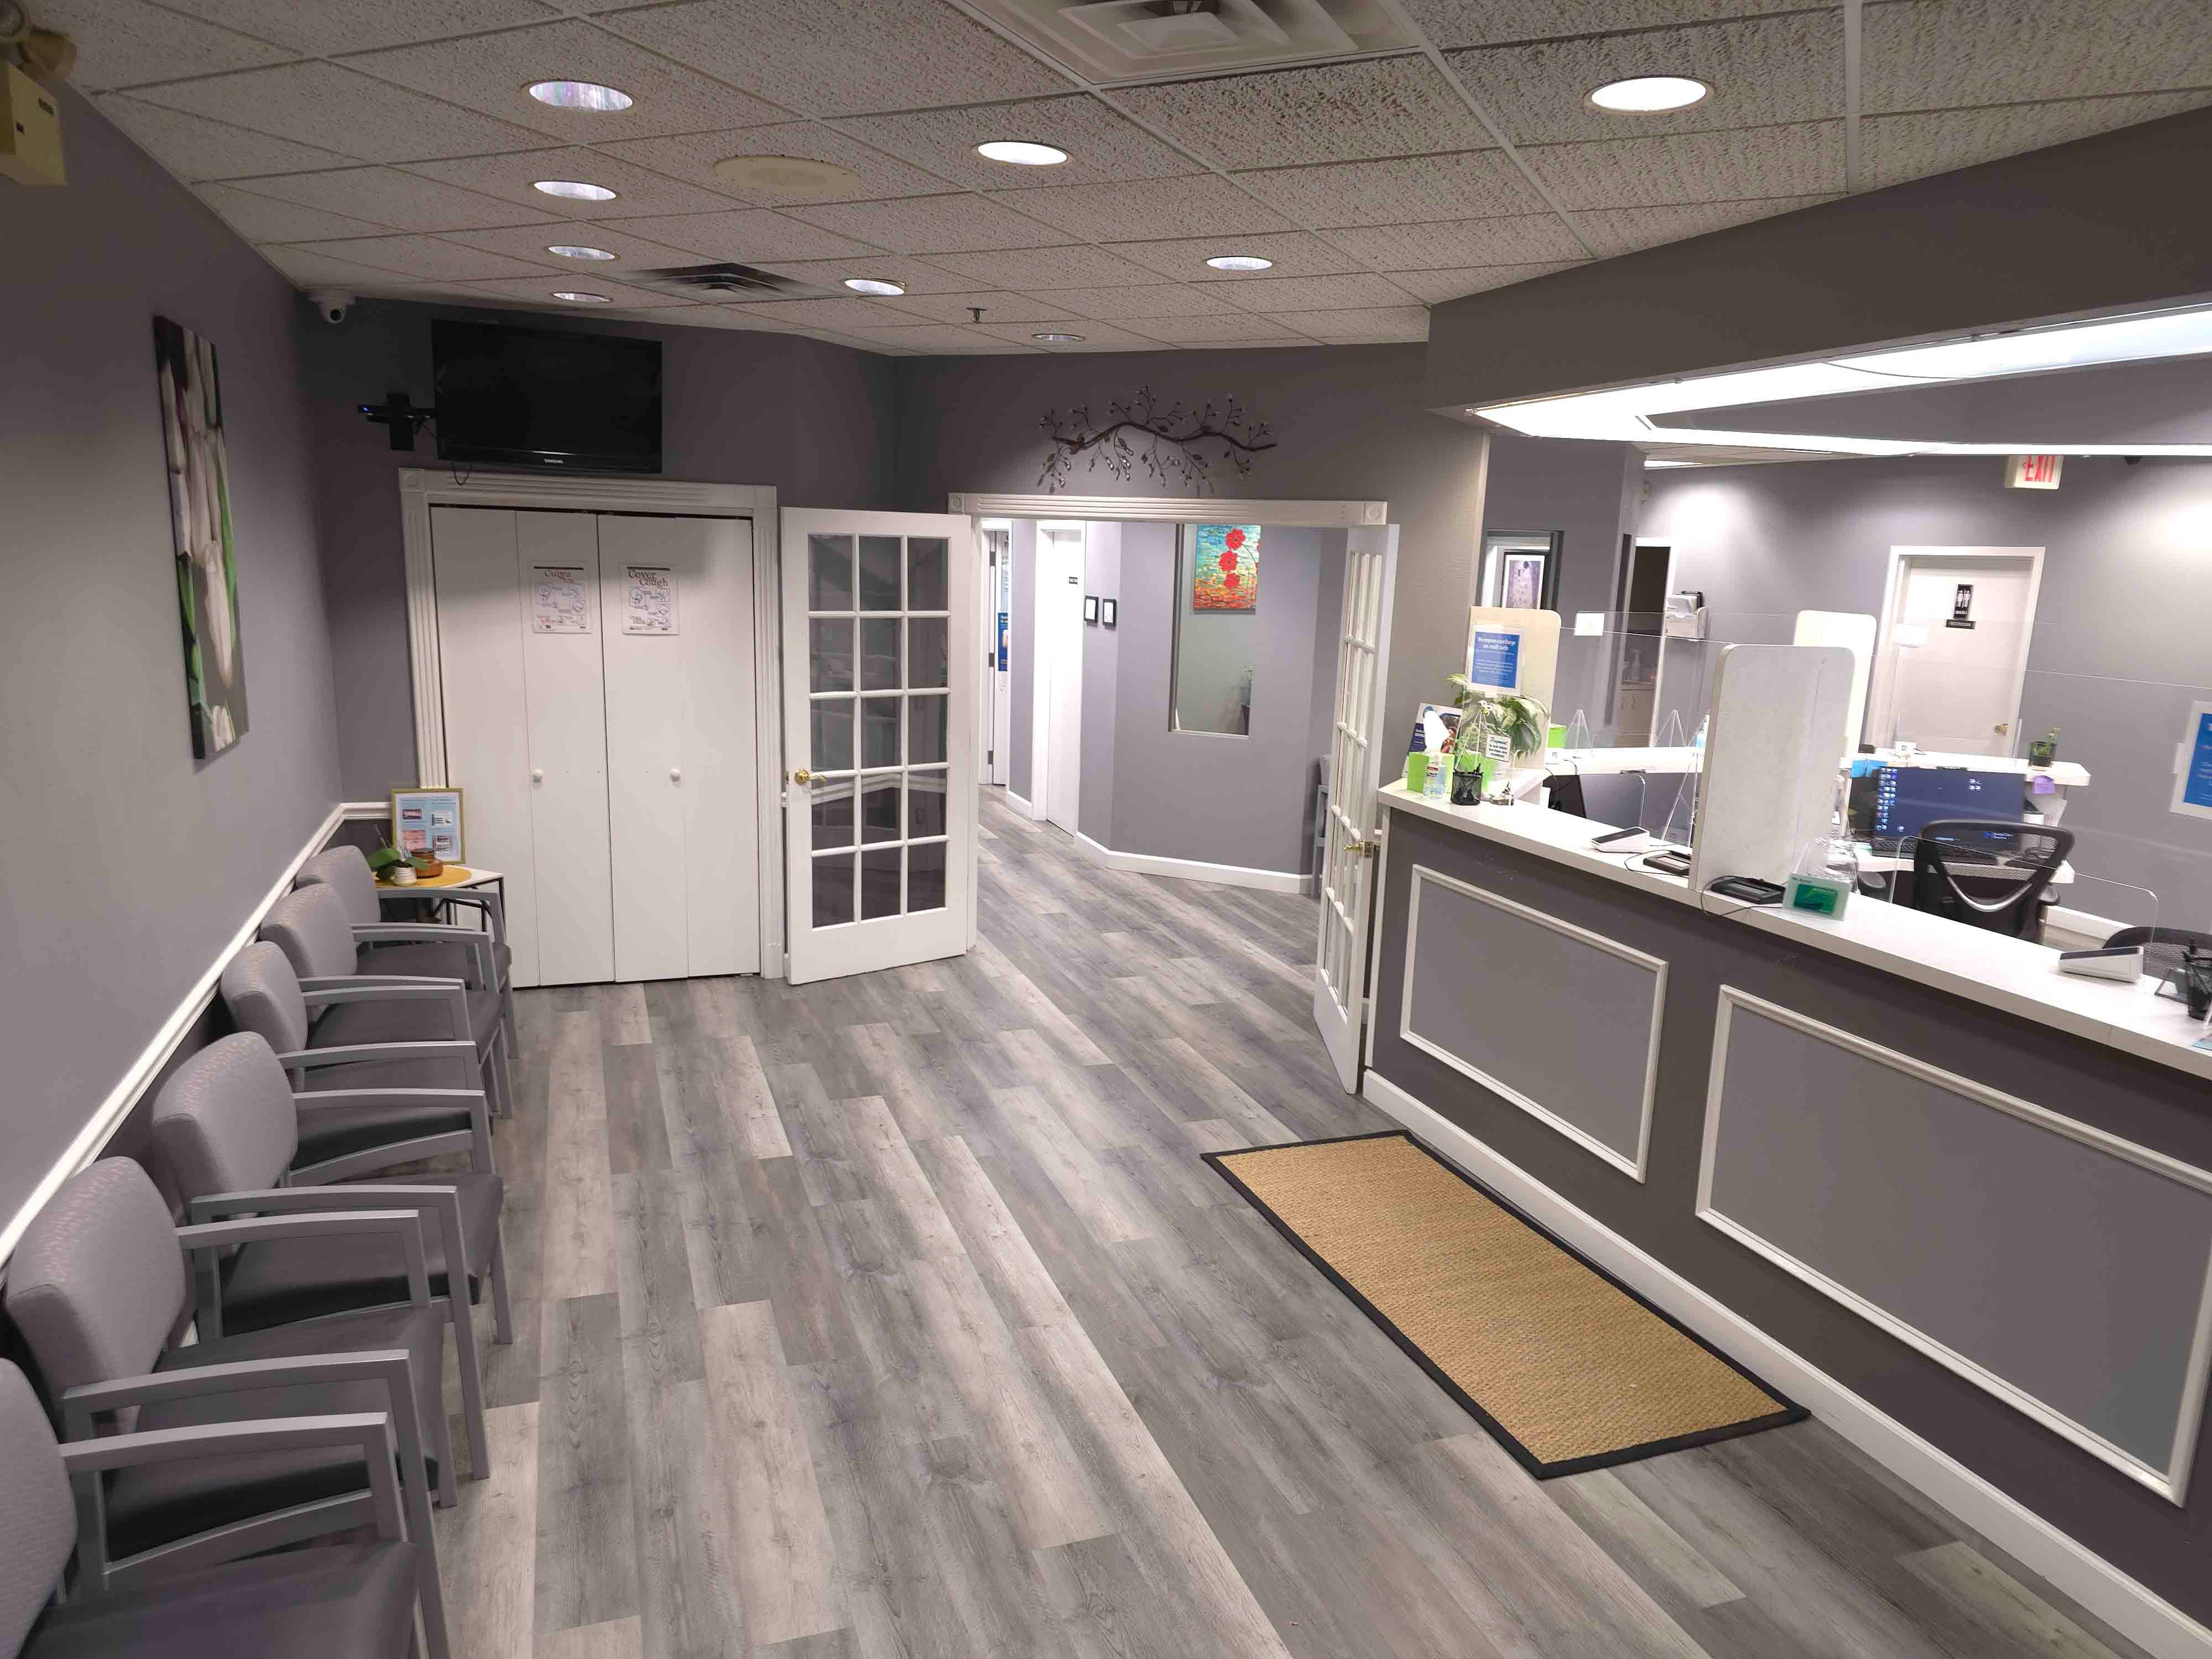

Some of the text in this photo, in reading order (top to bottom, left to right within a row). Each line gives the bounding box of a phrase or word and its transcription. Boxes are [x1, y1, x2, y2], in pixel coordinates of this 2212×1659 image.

[2025, 455, 2056, 482] EXIT
[628, 570, 656, 580] Cover
[638, 578, 669, 588] Cough
